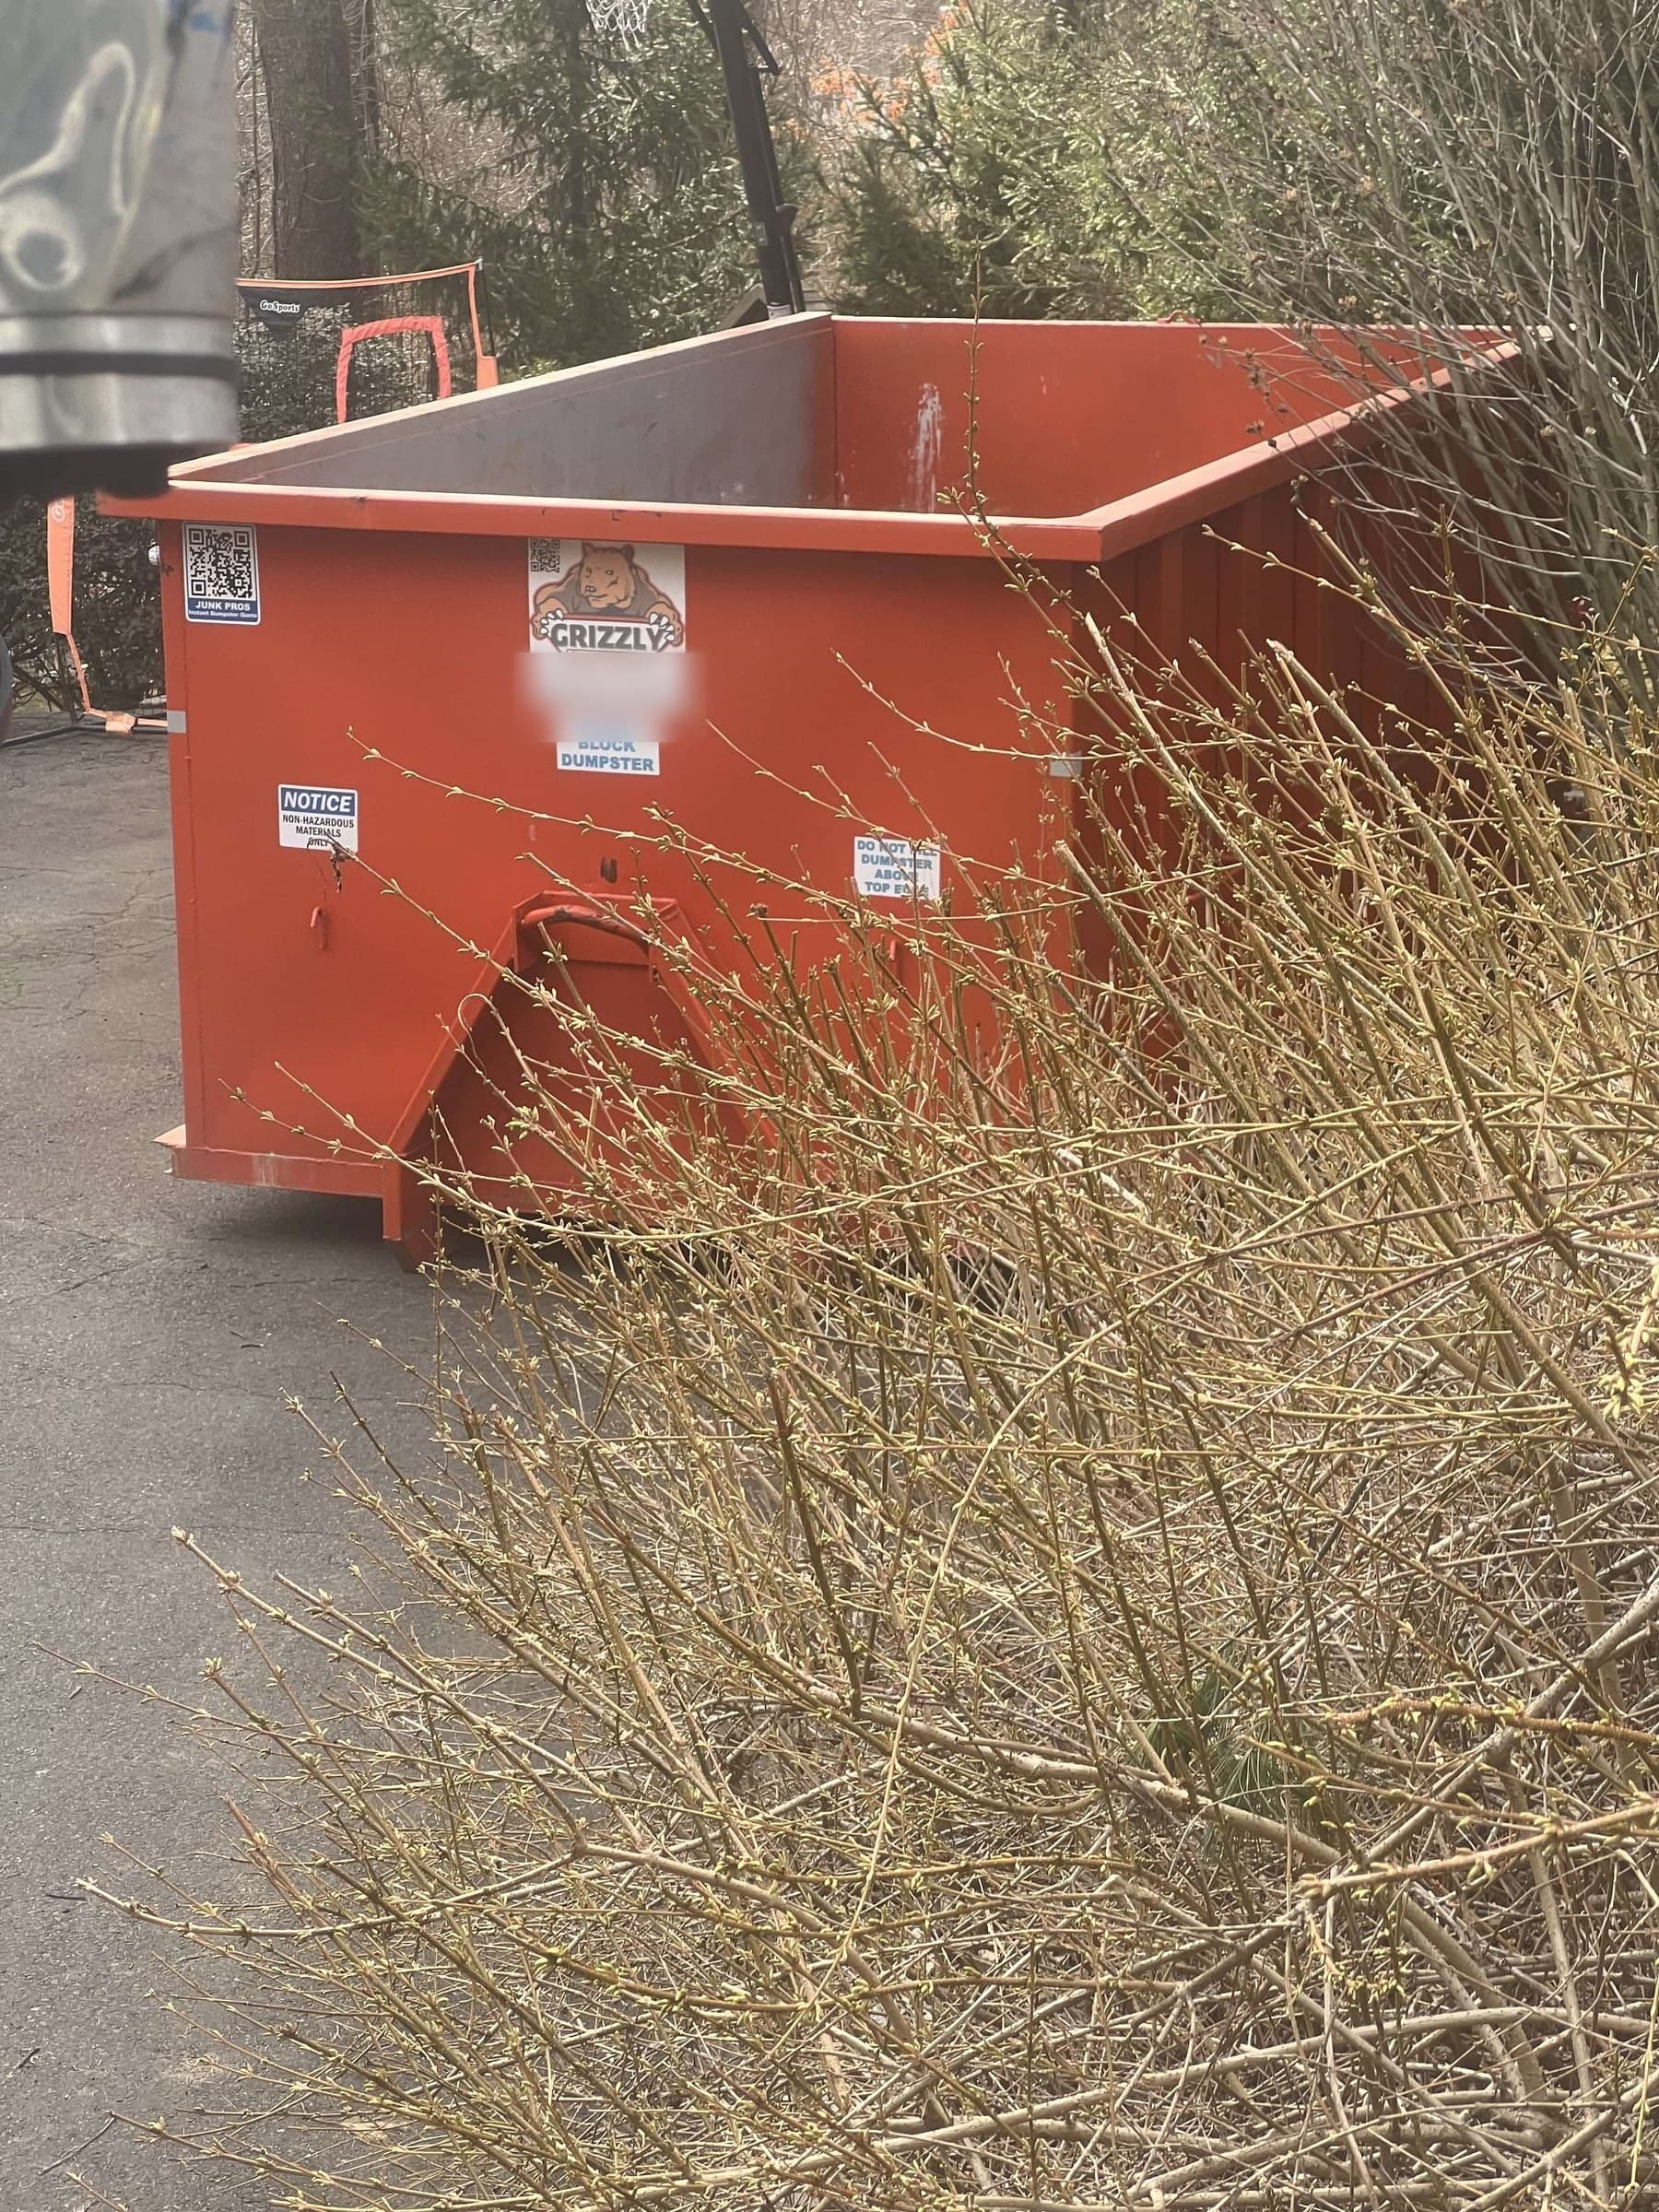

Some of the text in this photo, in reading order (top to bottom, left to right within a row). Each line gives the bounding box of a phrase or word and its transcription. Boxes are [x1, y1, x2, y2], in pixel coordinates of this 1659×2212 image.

[260, 300, 300, 313] GoSports
[195, 601, 251, 611] JUNK PROS
[551, 623, 665, 651] GRIZZLY
[561, 753, 654, 771] DUMPSTER
[284, 791, 352, 813] NOTICE
[282, 814, 354, 829] NON-HAZARDOUS
[295, 826, 341, 838] MATERIALS
[308, 837, 329, 847] ONLY
[857, 840, 875, 851] DO
[879, 841, 906, 853] NOT
[865, 881, 890, 893] TOP
